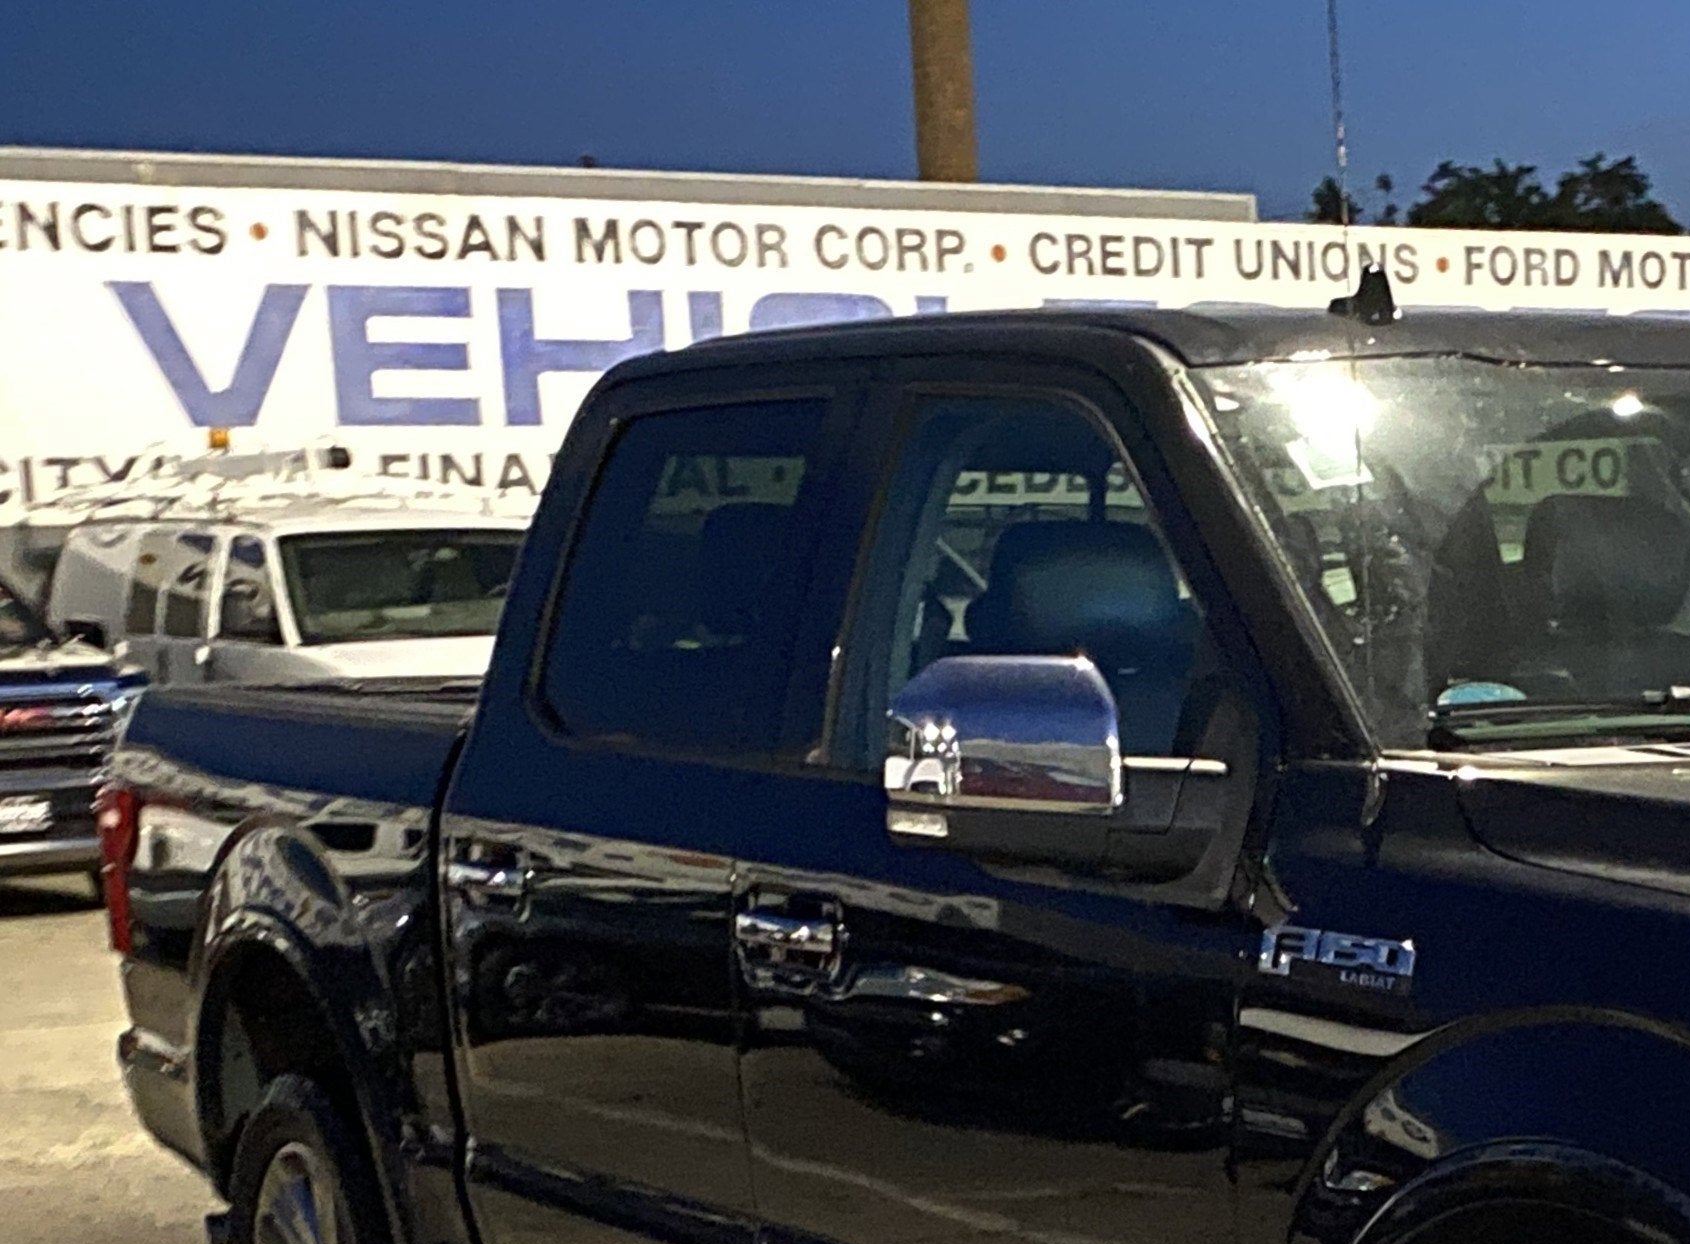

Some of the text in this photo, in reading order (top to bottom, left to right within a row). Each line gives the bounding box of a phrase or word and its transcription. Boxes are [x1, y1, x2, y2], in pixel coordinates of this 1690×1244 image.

[0, 201, 227, 255] NCIES
[295, 209, 546, 262] NISSAN
[573, 217, 788, 268] MOTOR
[814, 225, 974, 273] CORP.
[1029, 232, 1212, 279] CREDIT
[1464, 246, 1580, 288] FORD
